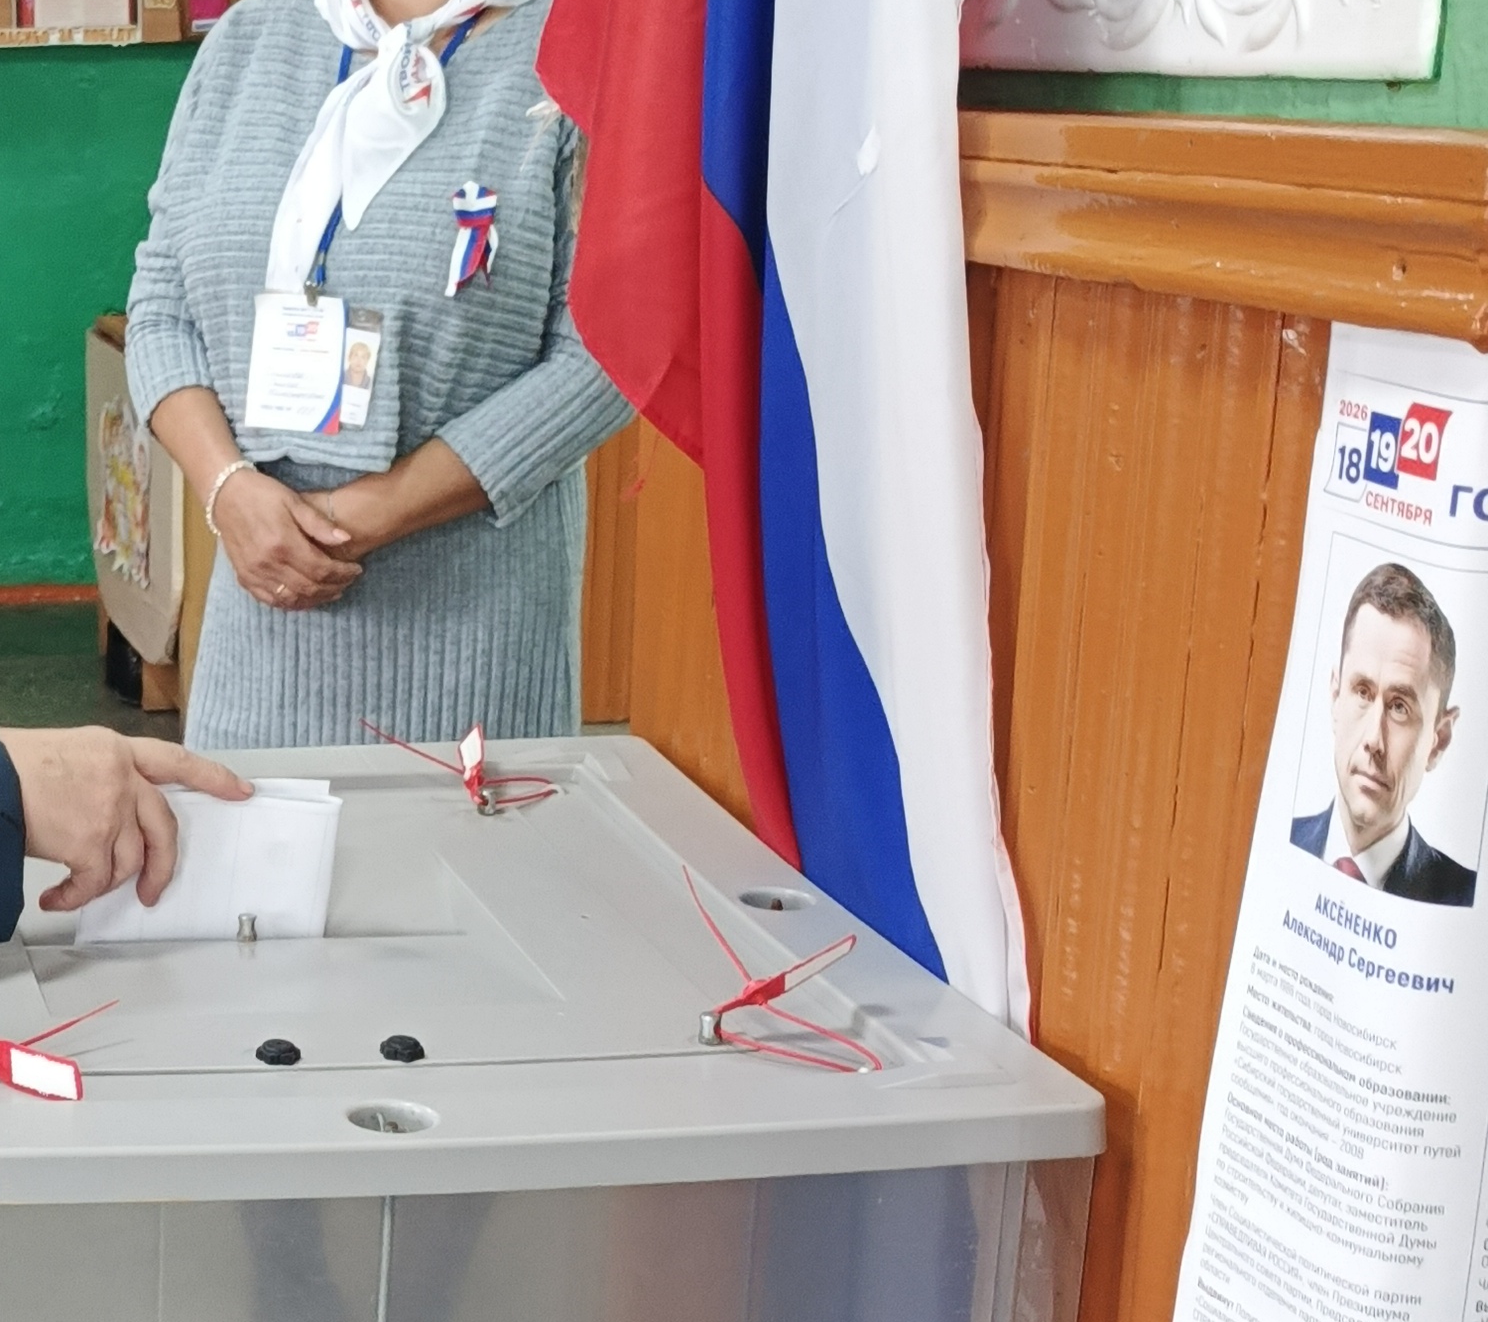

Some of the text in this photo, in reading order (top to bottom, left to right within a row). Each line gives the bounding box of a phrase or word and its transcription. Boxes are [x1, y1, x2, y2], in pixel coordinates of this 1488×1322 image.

[1339, 399, 1368, 421] 2026
[1338, 417, 1440, 484] 18 19 20
[1365, 491, 1433, 526] СЕНТЯБРЯ
[1315, 893, 1397, 949] АКСЁНЕНКО
[1283, 909, 1455, 994] Александр Сергеевич
[1333, 1012, 1397, 1050] Новосибирск
[1335, 1037, 1402, 1075] Новосибирск
[1344, 1105, 1424, 1138] образования
[1372, 1100, 1457, 1124] учреждение
[1342, 1125, 1418, 1155] университет
[1423, 1145, 1461, 1159] путей
[1345, 1204, 1428, 1232] заместитель
[1377, 1194, 1445, 1216] Собрания
[1303, 1197, 1395, 1244] Государственной
[1398, 1233, 1437, 1251] Думы
[1298, 1255, 1370, 1297] политической
[1332, 1289, 1410, 1322] Президиума
